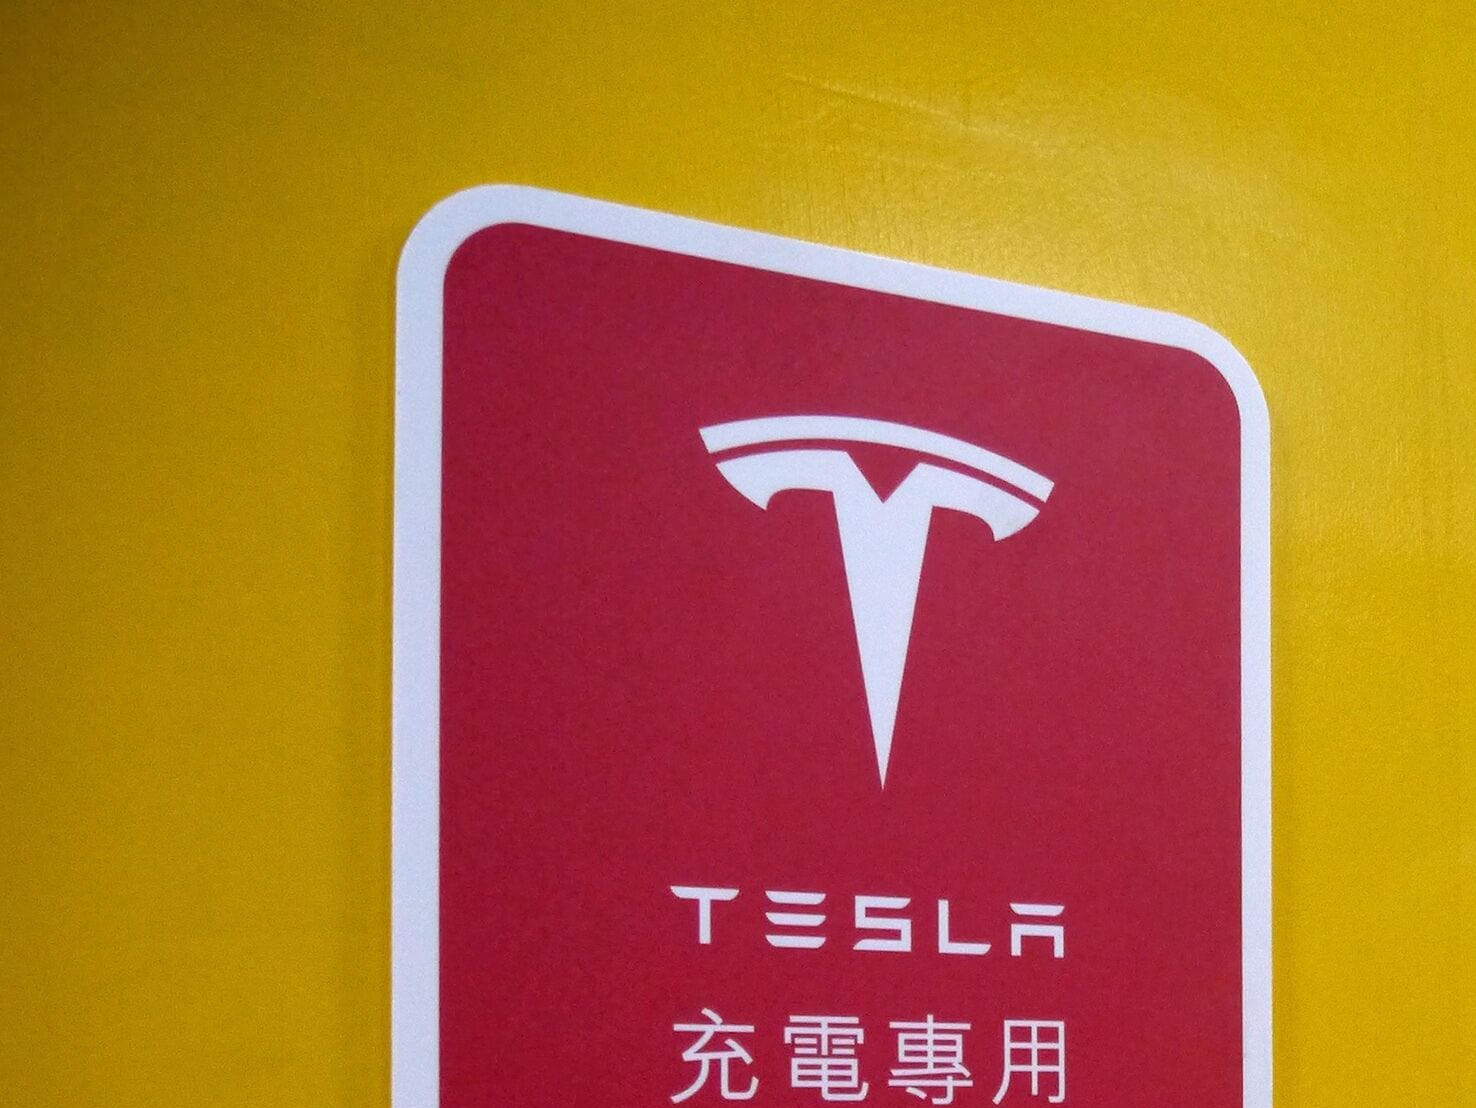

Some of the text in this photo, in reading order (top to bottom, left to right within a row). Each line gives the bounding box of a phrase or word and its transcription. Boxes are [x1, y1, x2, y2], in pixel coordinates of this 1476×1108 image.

[669, 885, 1065, 959] TESLA
[669, 1007, 1066, 1105] 充電專用
